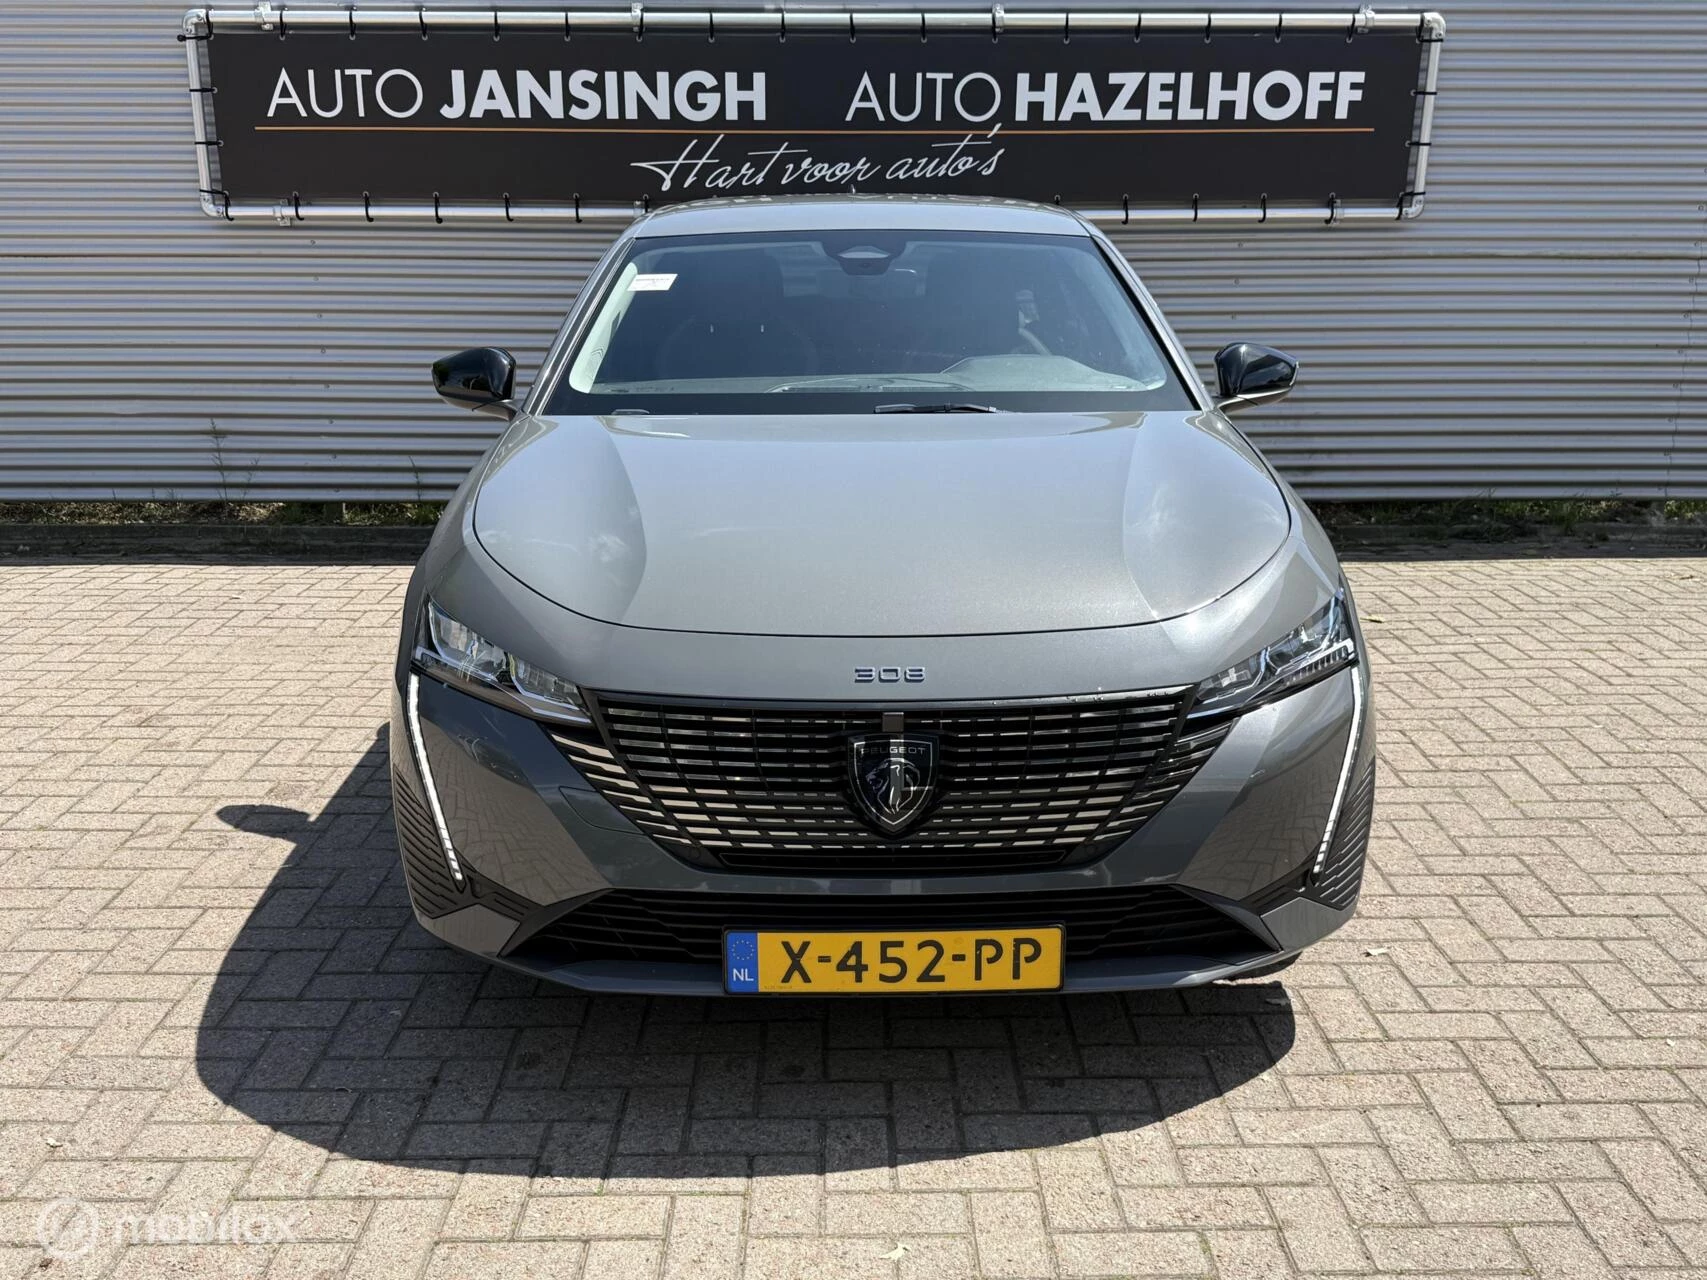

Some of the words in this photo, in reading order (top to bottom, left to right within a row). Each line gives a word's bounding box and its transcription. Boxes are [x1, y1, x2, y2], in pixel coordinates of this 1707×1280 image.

[267, 67, 424, 119] AUTO
[440, 69, 766, 122] JANSINGH
[845, 72, 1001, 122] AUTO
[1013, 70, 1366, 122] HAZELHOFF
[630, 134, 808, 192] Hart
[781, 155, 882, 185] voor
[885, 122, 1005, 178] auto's
[854, 666, 926, 683] 308
[733, 968, 754, 982] NL
[780, 936, 1043, 984] X-452-PP
